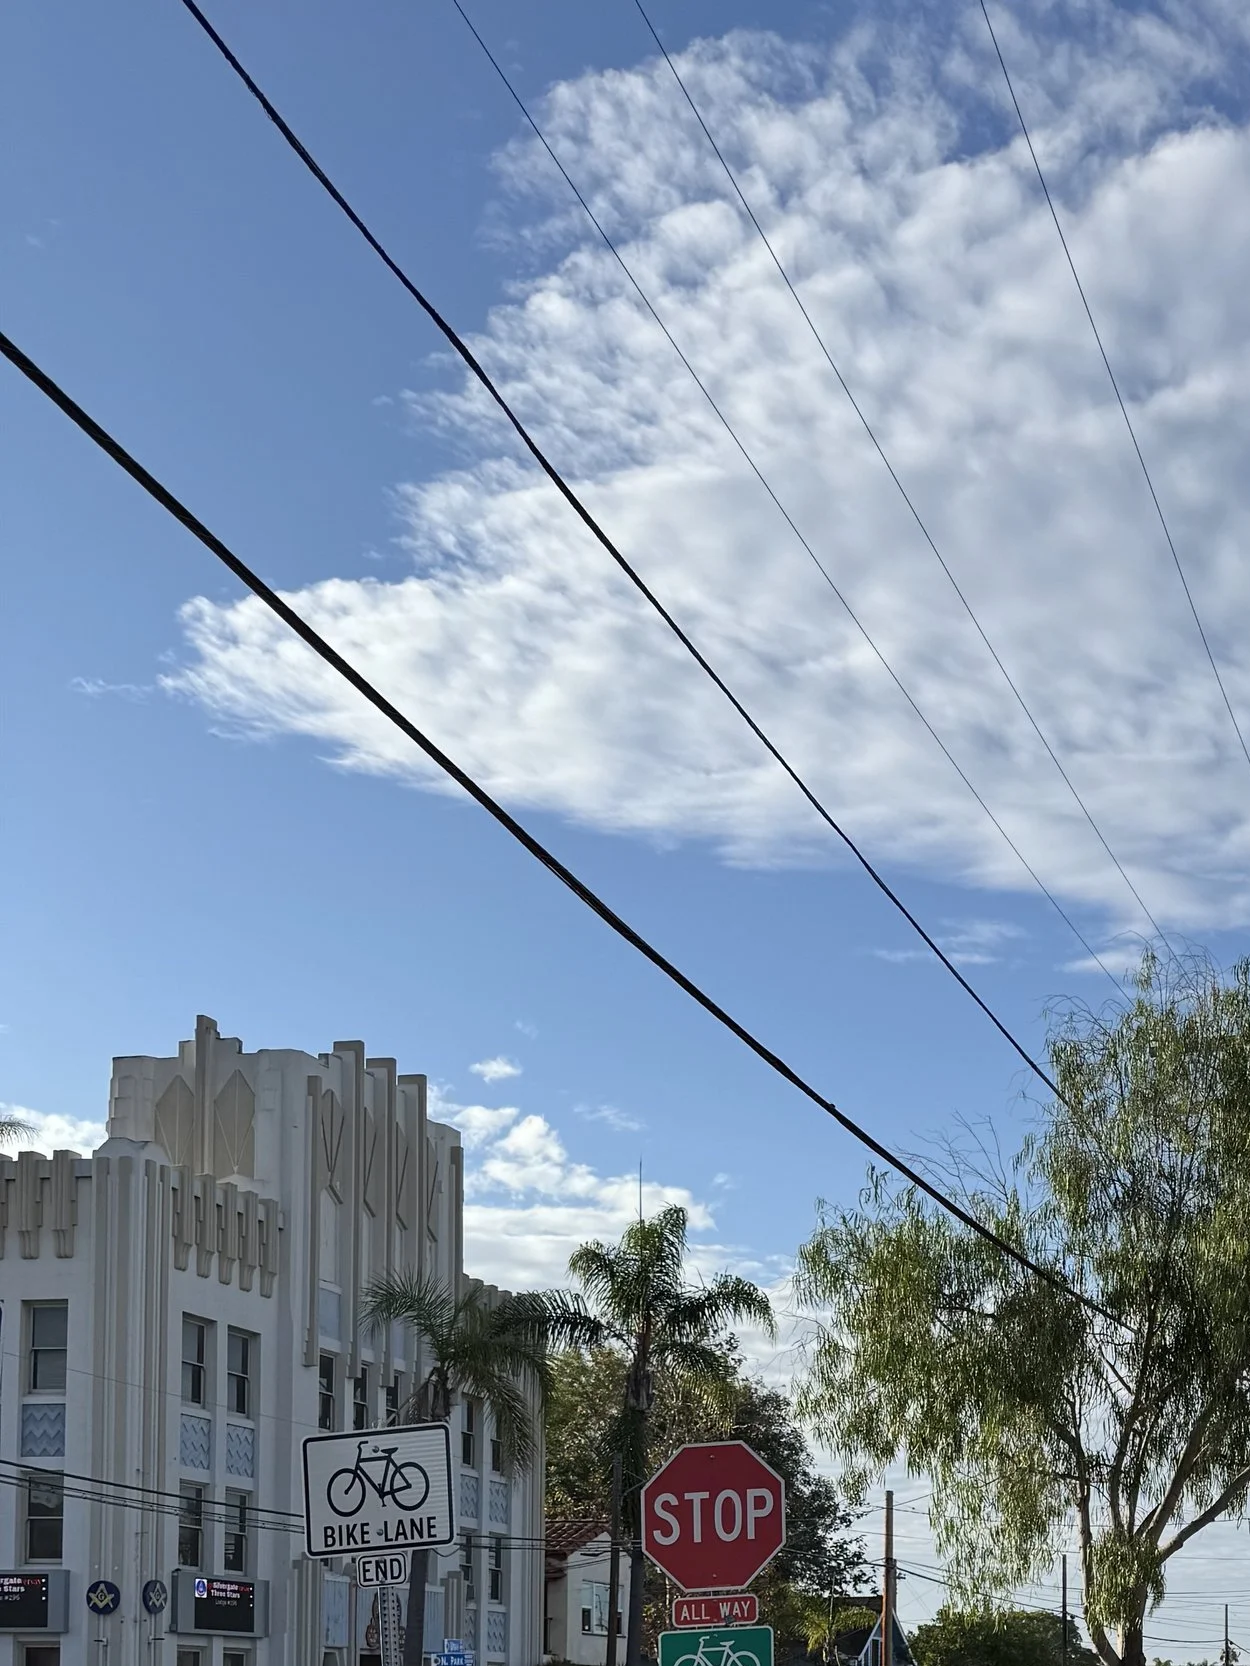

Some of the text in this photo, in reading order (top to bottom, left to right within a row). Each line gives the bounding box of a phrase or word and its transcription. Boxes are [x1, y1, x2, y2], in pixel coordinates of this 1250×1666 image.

[653, 1487, 774, 1546] STOP
[323, 1516, 437, 1548] BIKE LANE
[362, 1558, 402, 1582] END
[680, 1600, 751, 1621] ALL WAY
